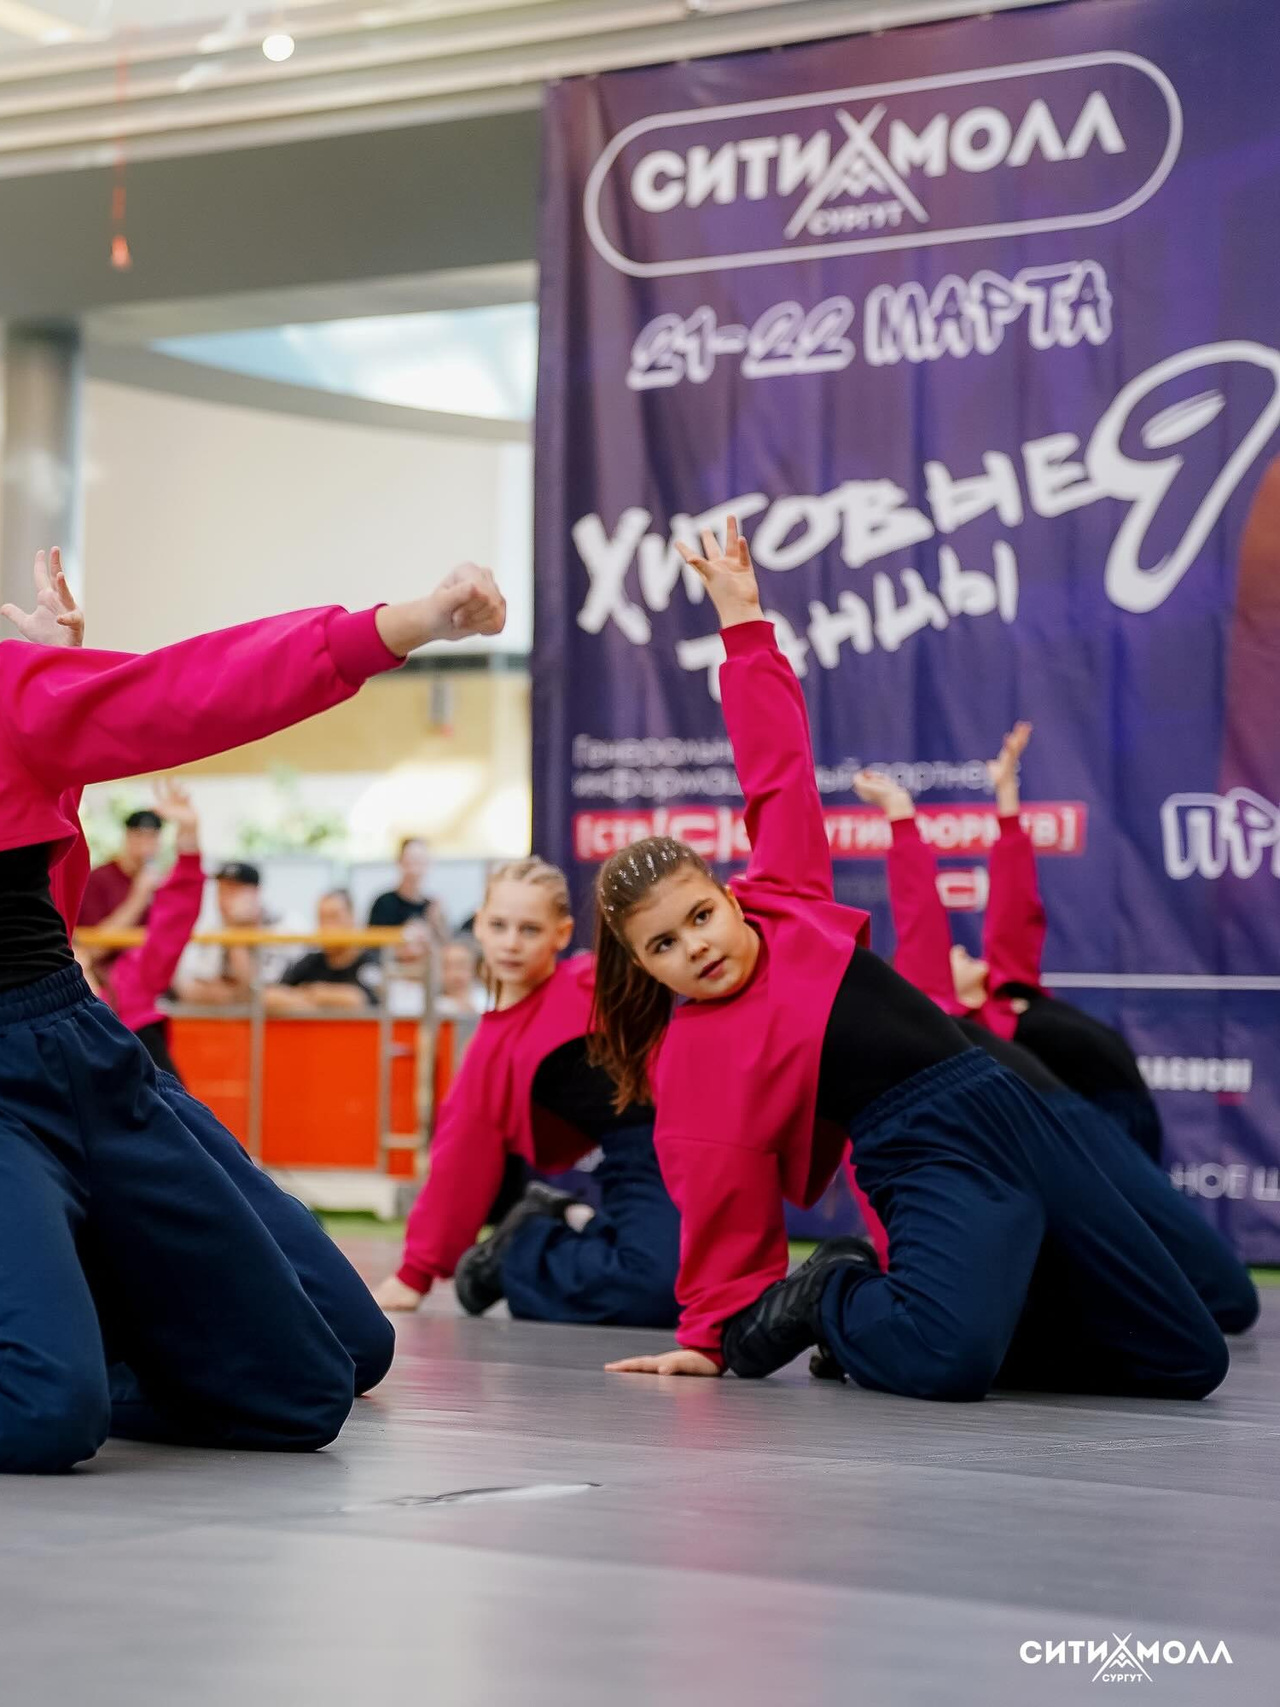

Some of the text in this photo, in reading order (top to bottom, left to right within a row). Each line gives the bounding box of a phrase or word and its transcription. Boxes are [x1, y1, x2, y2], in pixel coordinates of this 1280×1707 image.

[628, 260, 1114, 391] 21-22 МАРТА
[1161, 786, 1280, 880] ПР
